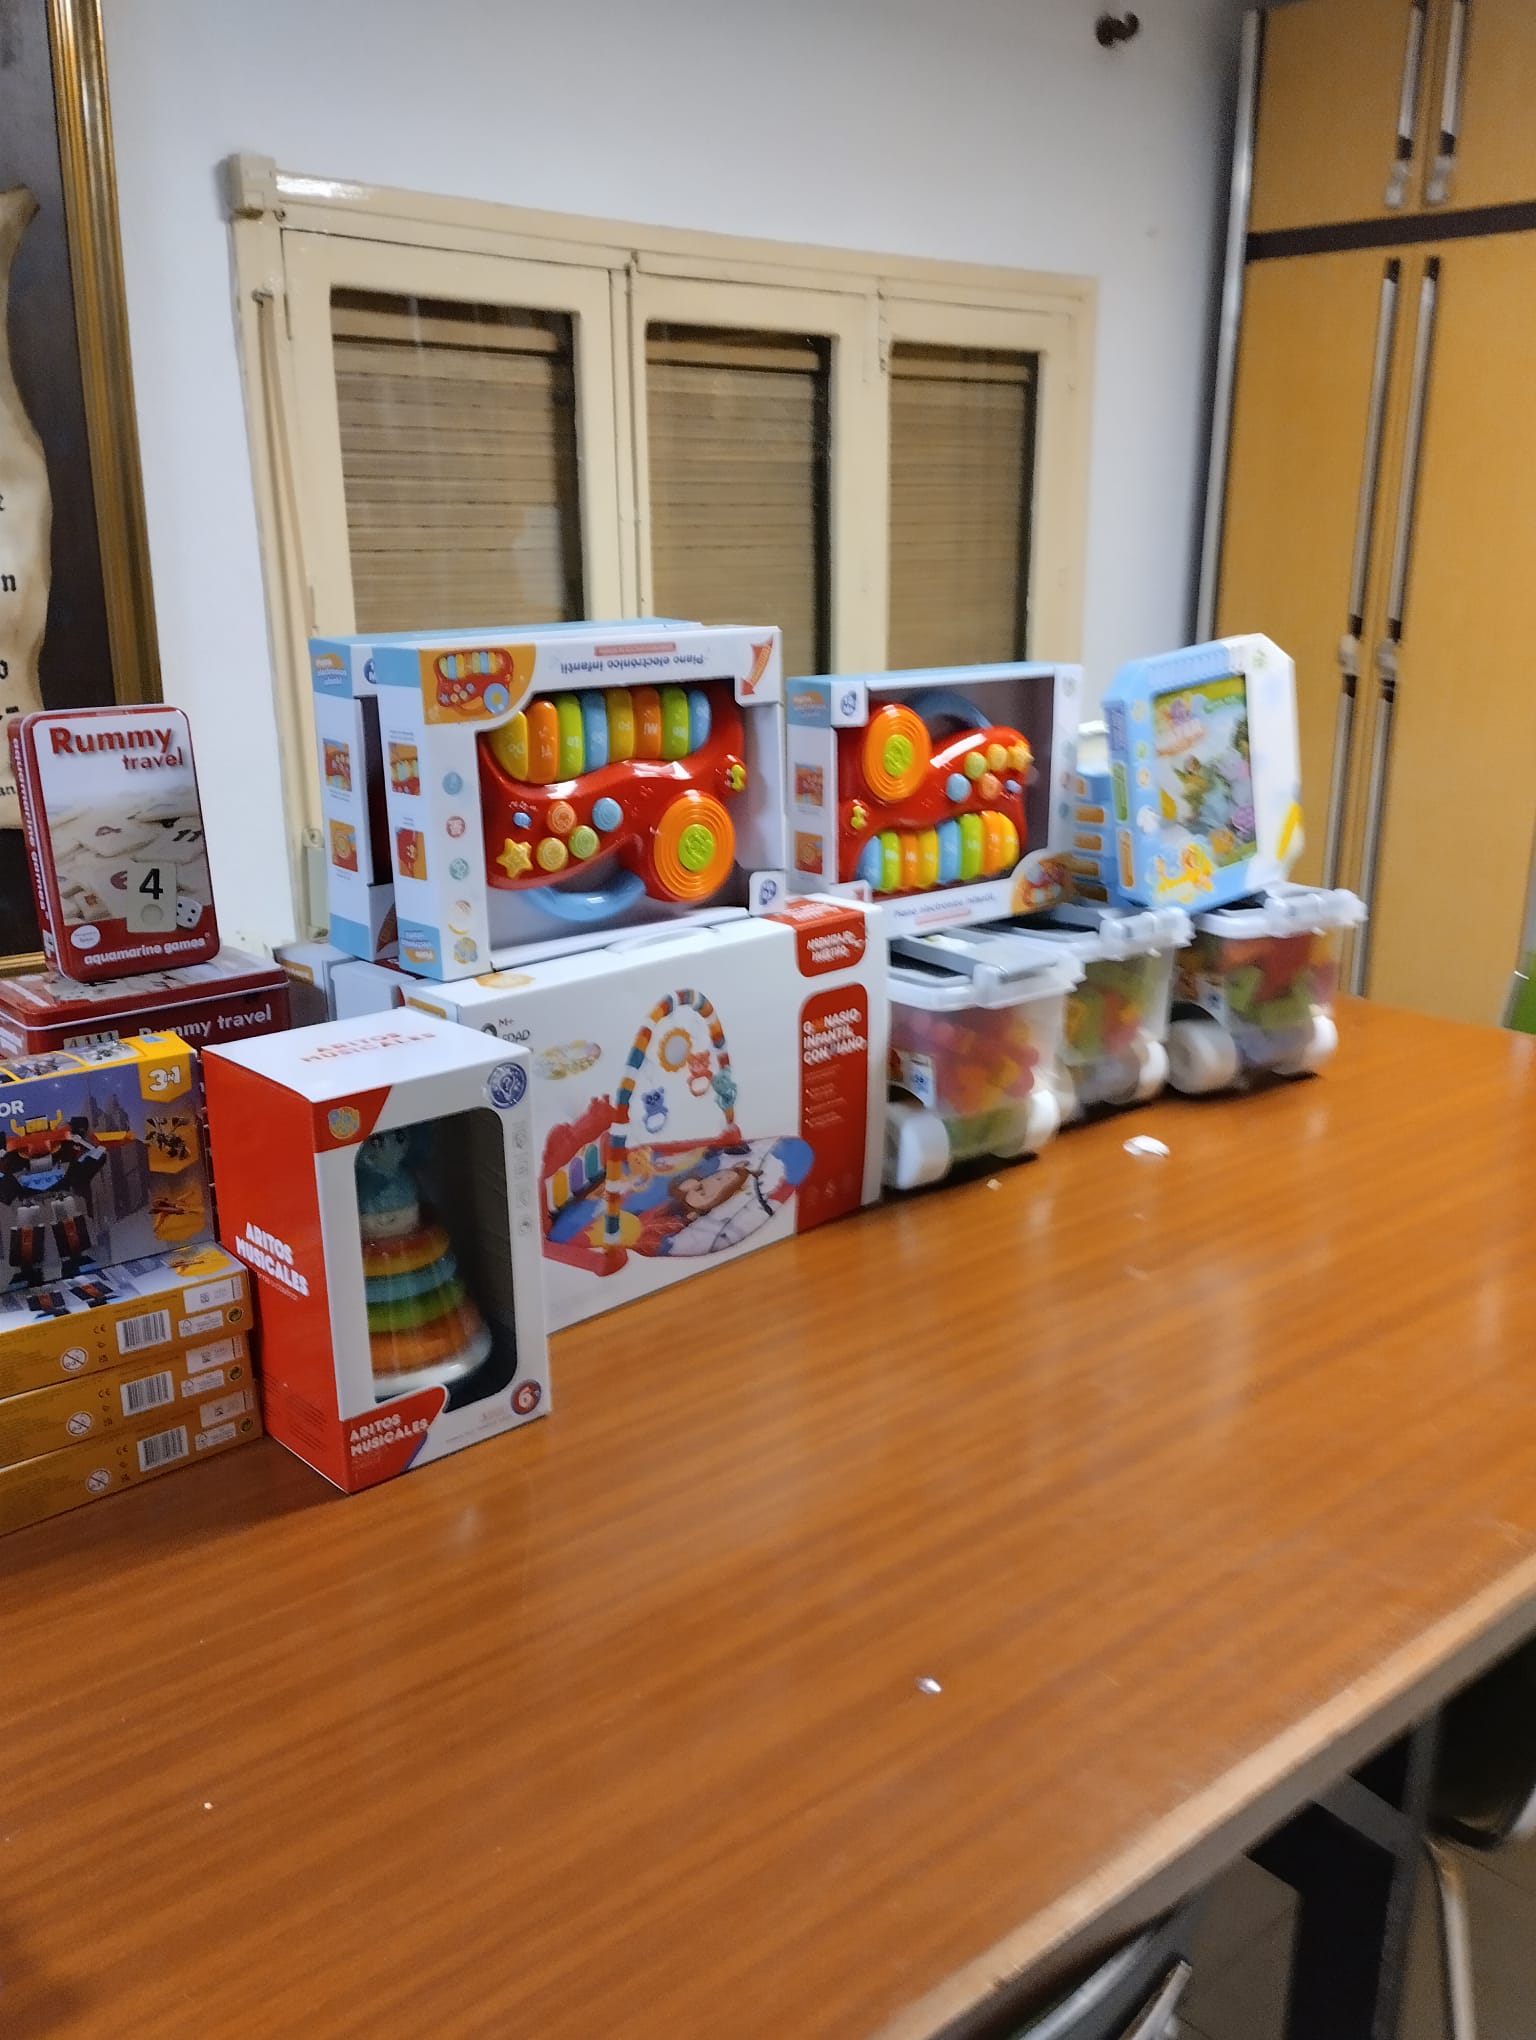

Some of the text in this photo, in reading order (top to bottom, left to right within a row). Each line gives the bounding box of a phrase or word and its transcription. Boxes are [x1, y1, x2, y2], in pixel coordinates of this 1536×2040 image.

[49, 727, 172, 754] Rummy
[122, 746, 184, 770] travel
[139, 868, 163, 900] 4
[84, 937, 206, 965] aquamarine games
[138, 1003, 272, 1038] Rmmy travel
[245, 1221, 295, 1266] ARITOS
[235, 1235, 310, 1297] MUSICALES
[350, 1413, 401, 1442] ARITOS
[350, 1418, 429, 1457] MUSICALES
